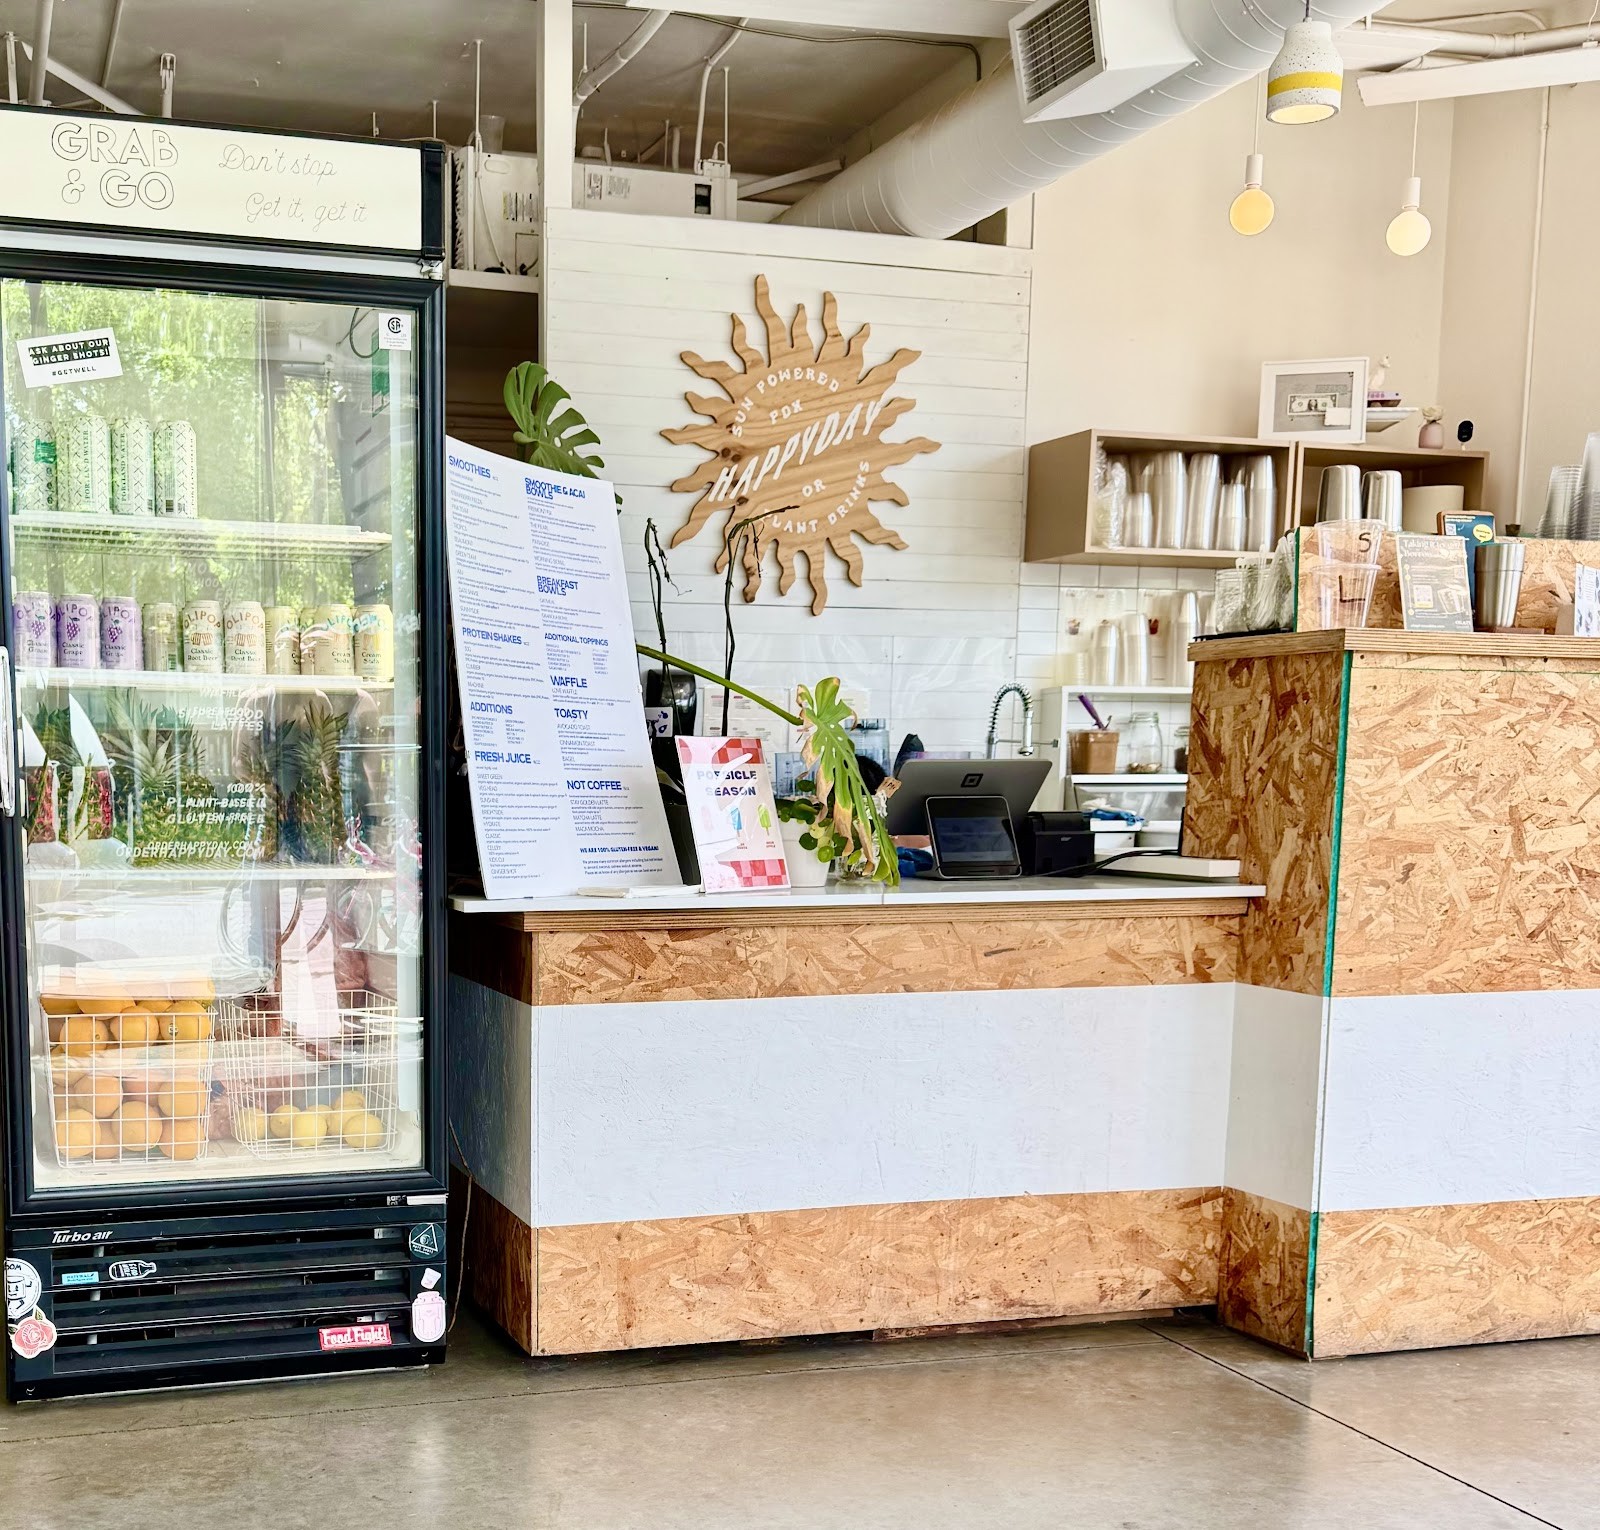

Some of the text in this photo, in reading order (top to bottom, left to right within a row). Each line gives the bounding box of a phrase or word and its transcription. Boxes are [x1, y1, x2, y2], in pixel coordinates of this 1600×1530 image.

[51, 122, 178, 168] GRAB
[219, 144, 337, 185] Don't stop
[61, 169, 174, 210] & GO
[246, 193, 280, 223] Get
[314, 201, 345, 232] get
[349, 204, 367, 222] it
[29, 339, 109, 356] ASK ABOUT OUR
[32, 354, 69, 365] GINGER
[52, 366, 97, 376] #GETWELL
[757, 367, 839, 393] POWERED
[732, 397, 753, 438] SUN
[769, 400, 803, 425] PDX
[708, 401, 882, 502] HAPPYDAY
[449, 455, 491, 478] SMOOTHIES
[525, 478, 562, 494] SMOOTHIE
[526, 486, 553, 500] BOWLS
[802, 479, 826, 498] OR
[827, 461, 870, 525] DRINKS
[1359, 532, 1372, 553] S
[537, 576, 578, 590] BREAKFAST
[538, 583, 566, 596] BOWLS
[1339, 575, 1365, 603] L
[101, 606, 135, 622] LIPO
[184, 610, 221, 629] OLIPOP
[227, 612, 264, 629] OLIPOP
[462, 627, 522, 644] PROTEIN SHAKES
[545, 633, 608, 646] ADDITIONAL TOPPINGS
[550, 675, 588, 688] WAFFLE
[470, 702, 513, 714] ADDITIONS
[554, 708, 588, 720] TOASTY
[475, 751, 532, 764] FRESH JUICE
[697, 770, 757, 780] POPSICLE
[567, 780, 585, 790] NOT
[587, 781, 622, 790] COFFEE
[705, 786, 757, 796] SEASON
[115, 847, 265, 859] ORDERHAPPYDAY.COM
[52, 1229, 113, 1244] Turbo air
[321, 1325, 388, 1346] Food Fight!
